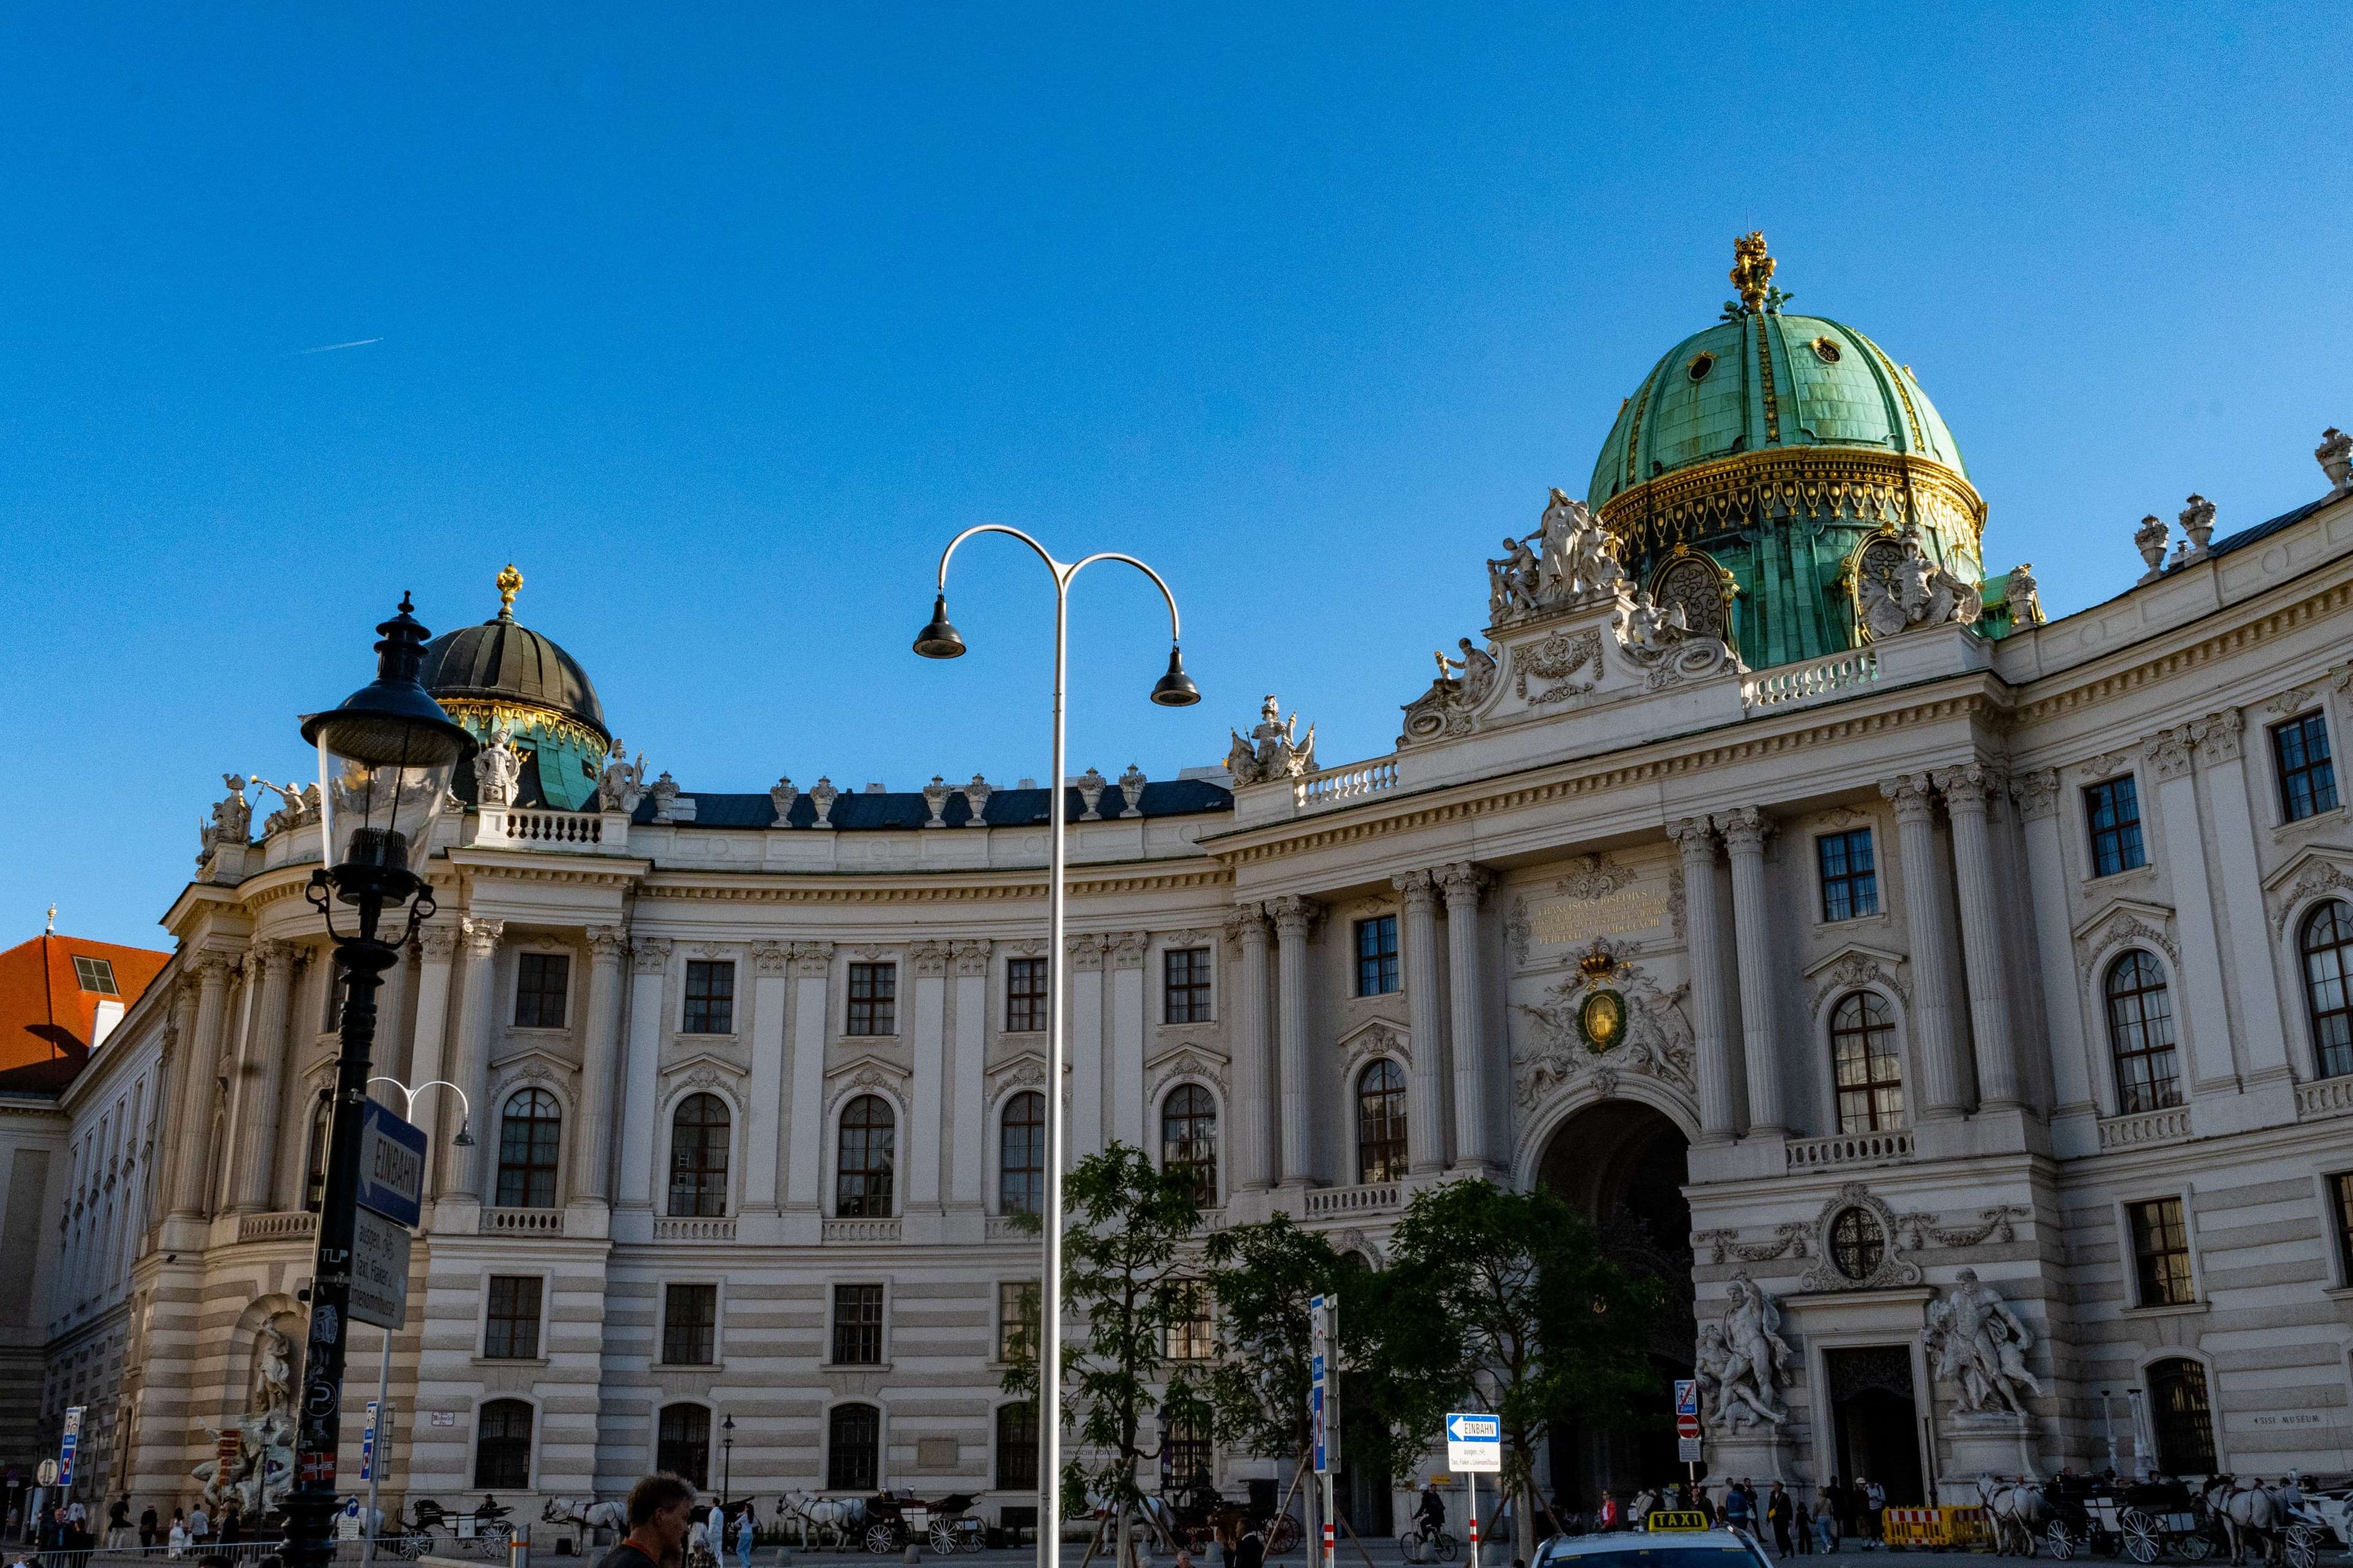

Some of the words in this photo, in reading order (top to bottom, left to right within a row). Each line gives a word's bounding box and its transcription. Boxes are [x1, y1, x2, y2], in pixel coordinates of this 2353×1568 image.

[374, 1137, 418, 1196] EINBAHN
[2282, 1415, 2319, 1423] MUSEUM
[1464, 1423, 1494, 1435] EINBAHN
[1656, 1514, 1699, 1526] TAXI
